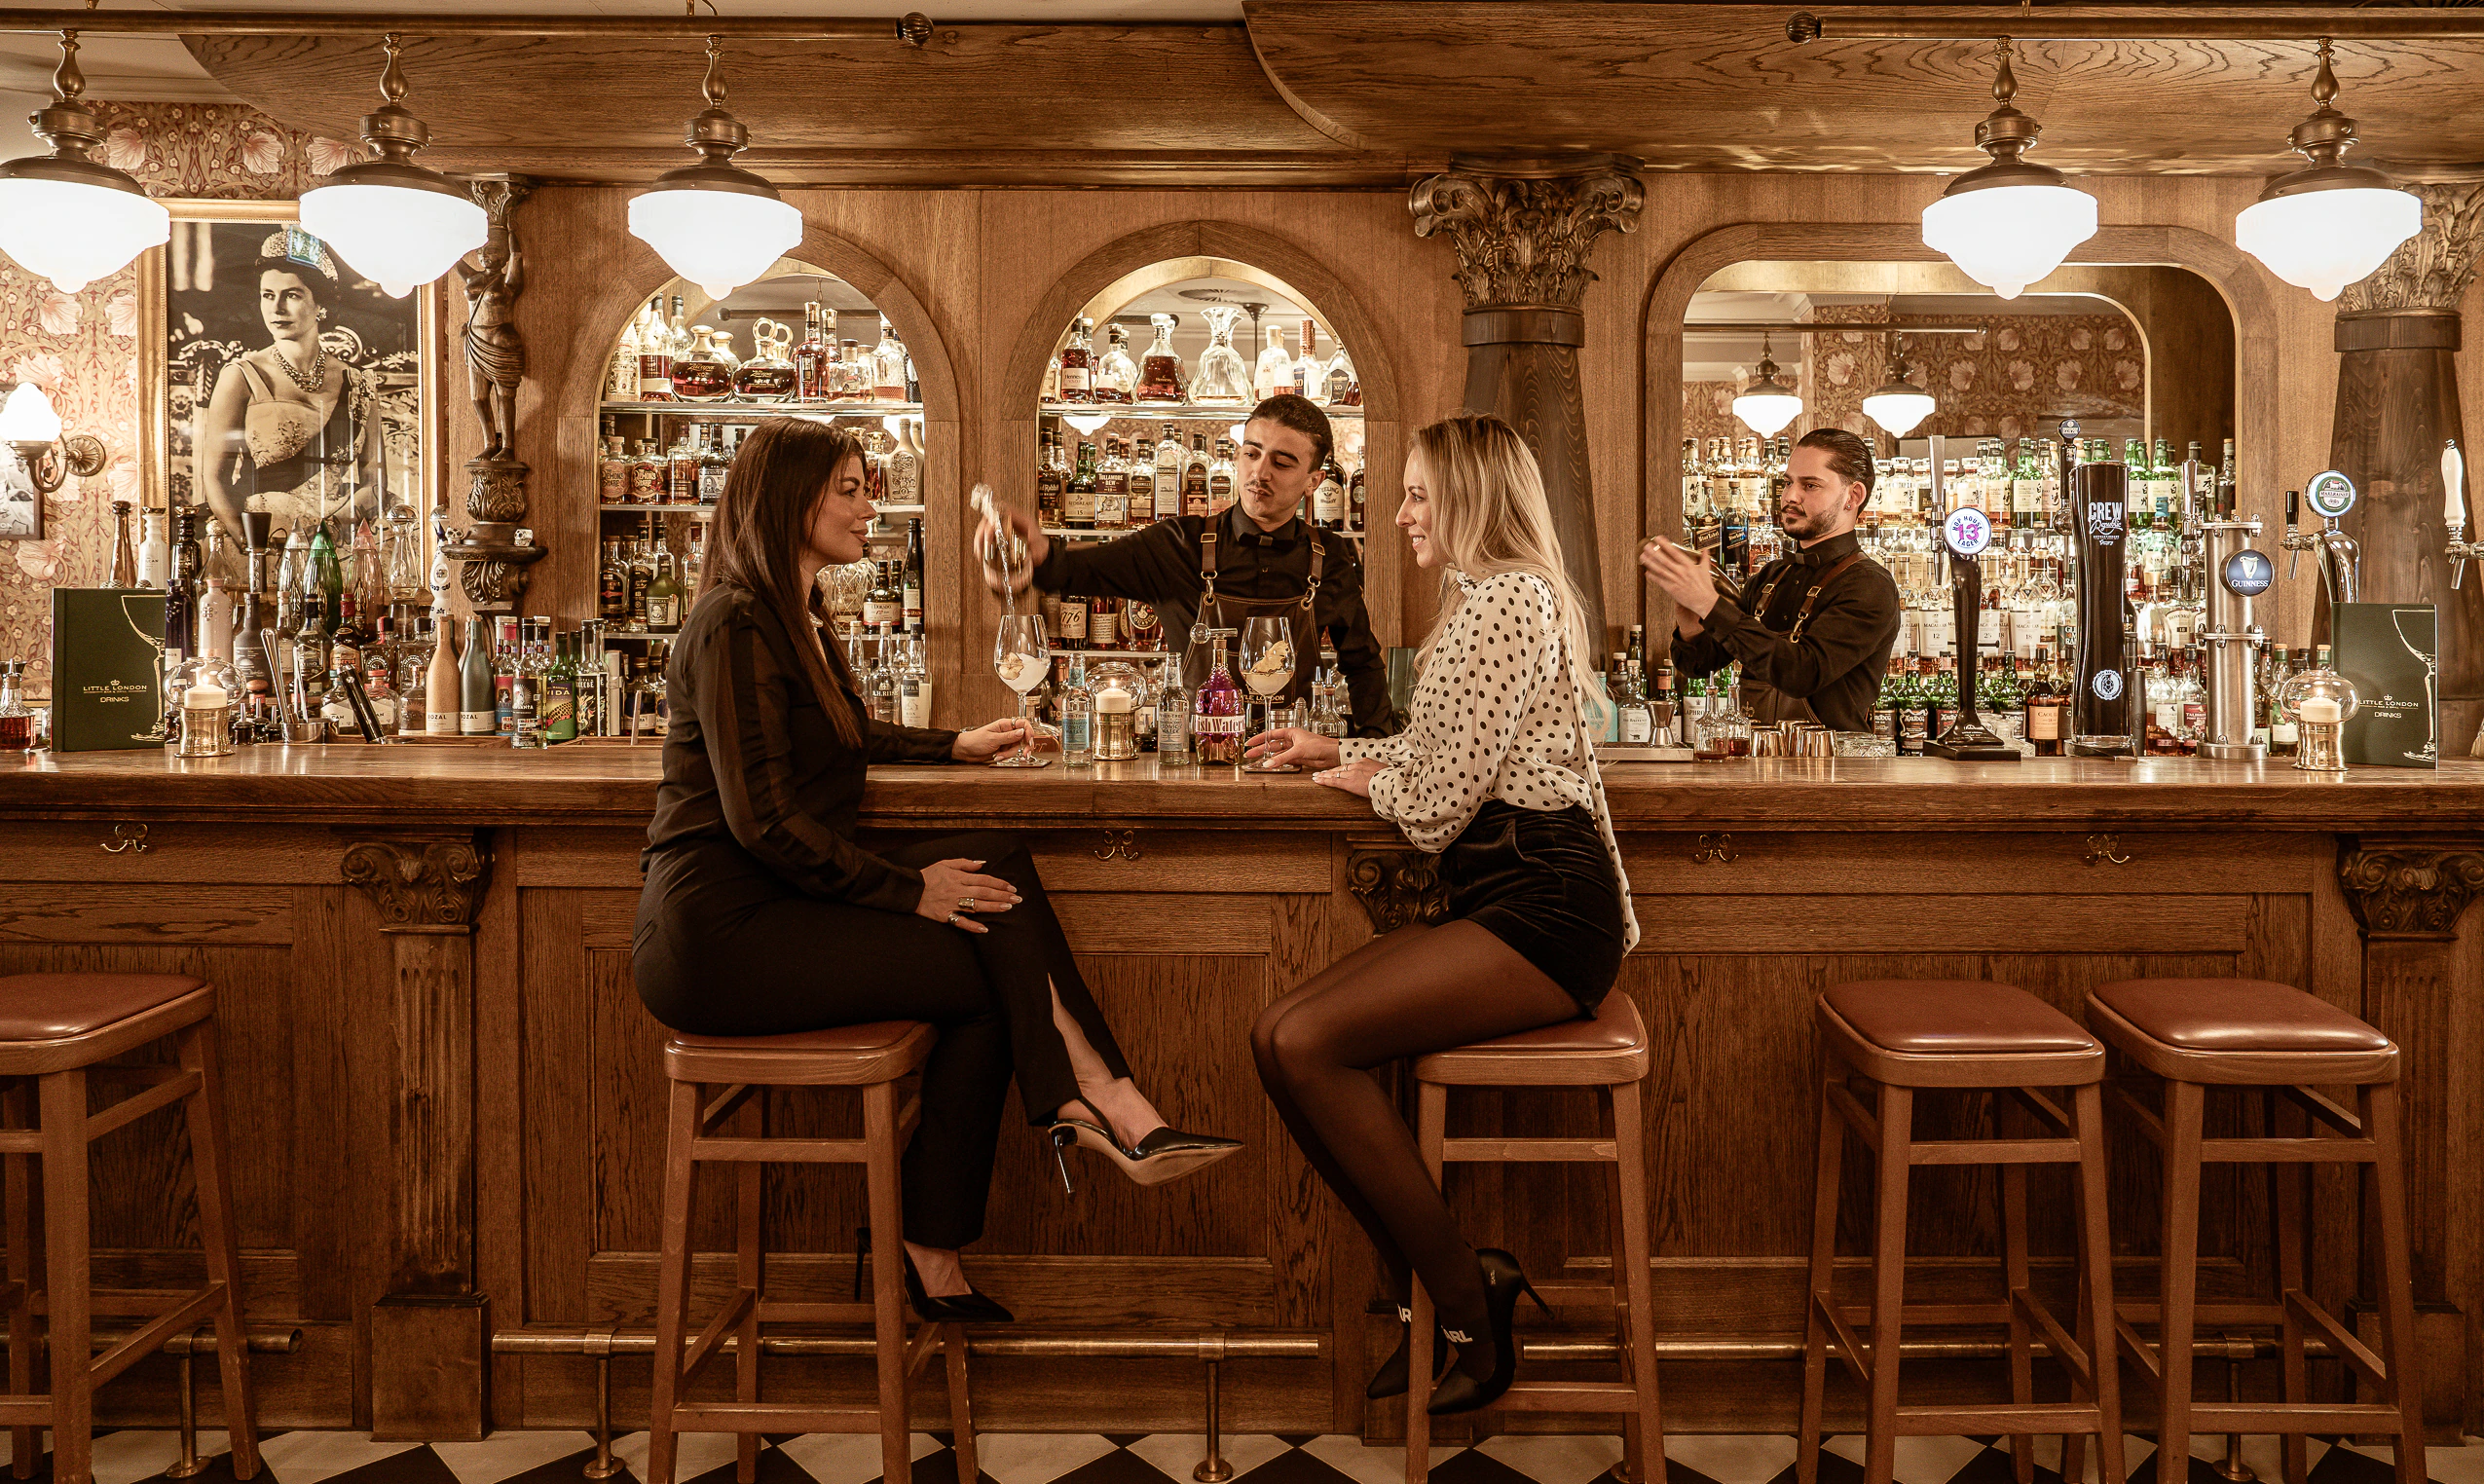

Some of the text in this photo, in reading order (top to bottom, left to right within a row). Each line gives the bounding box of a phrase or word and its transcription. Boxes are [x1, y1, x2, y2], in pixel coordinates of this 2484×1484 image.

[2088, 501, 2123, 521] CREW
[1952, 515, 1983, 531] HOP HOUSE
[1955, 523, 1980, 540] 13
[1957, 538, 1979, 547] LAGER
[2231, 579, 2269, 588] GUINNESS
[1060, 611, 1082, 624] 776
